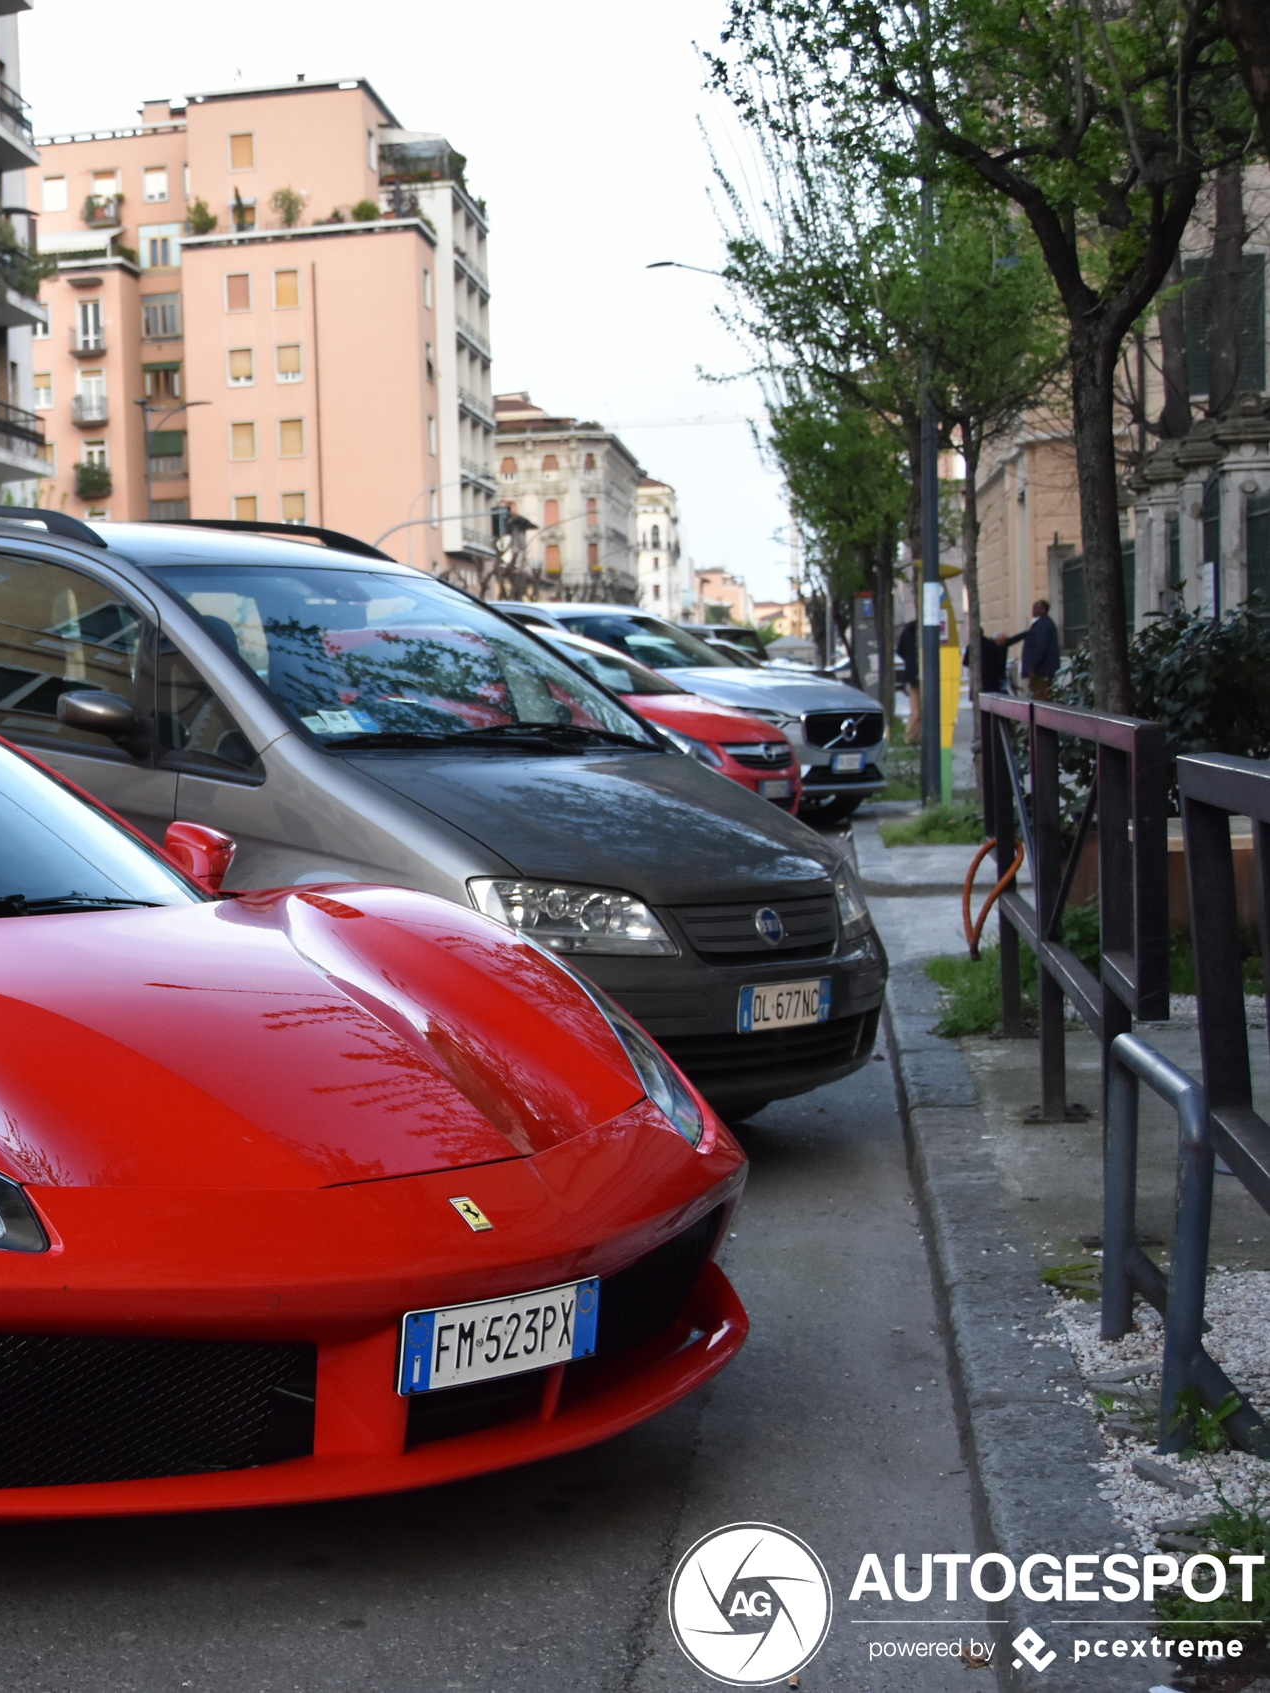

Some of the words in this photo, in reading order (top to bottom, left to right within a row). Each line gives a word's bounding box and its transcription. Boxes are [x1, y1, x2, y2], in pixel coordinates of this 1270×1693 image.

[753, 995, 770, 1022] DL
[776, 988, 819, 1020] 677NC
[435, 1320, 476, 1373] FM
[484, 1299, 574, 1364] 523PX
